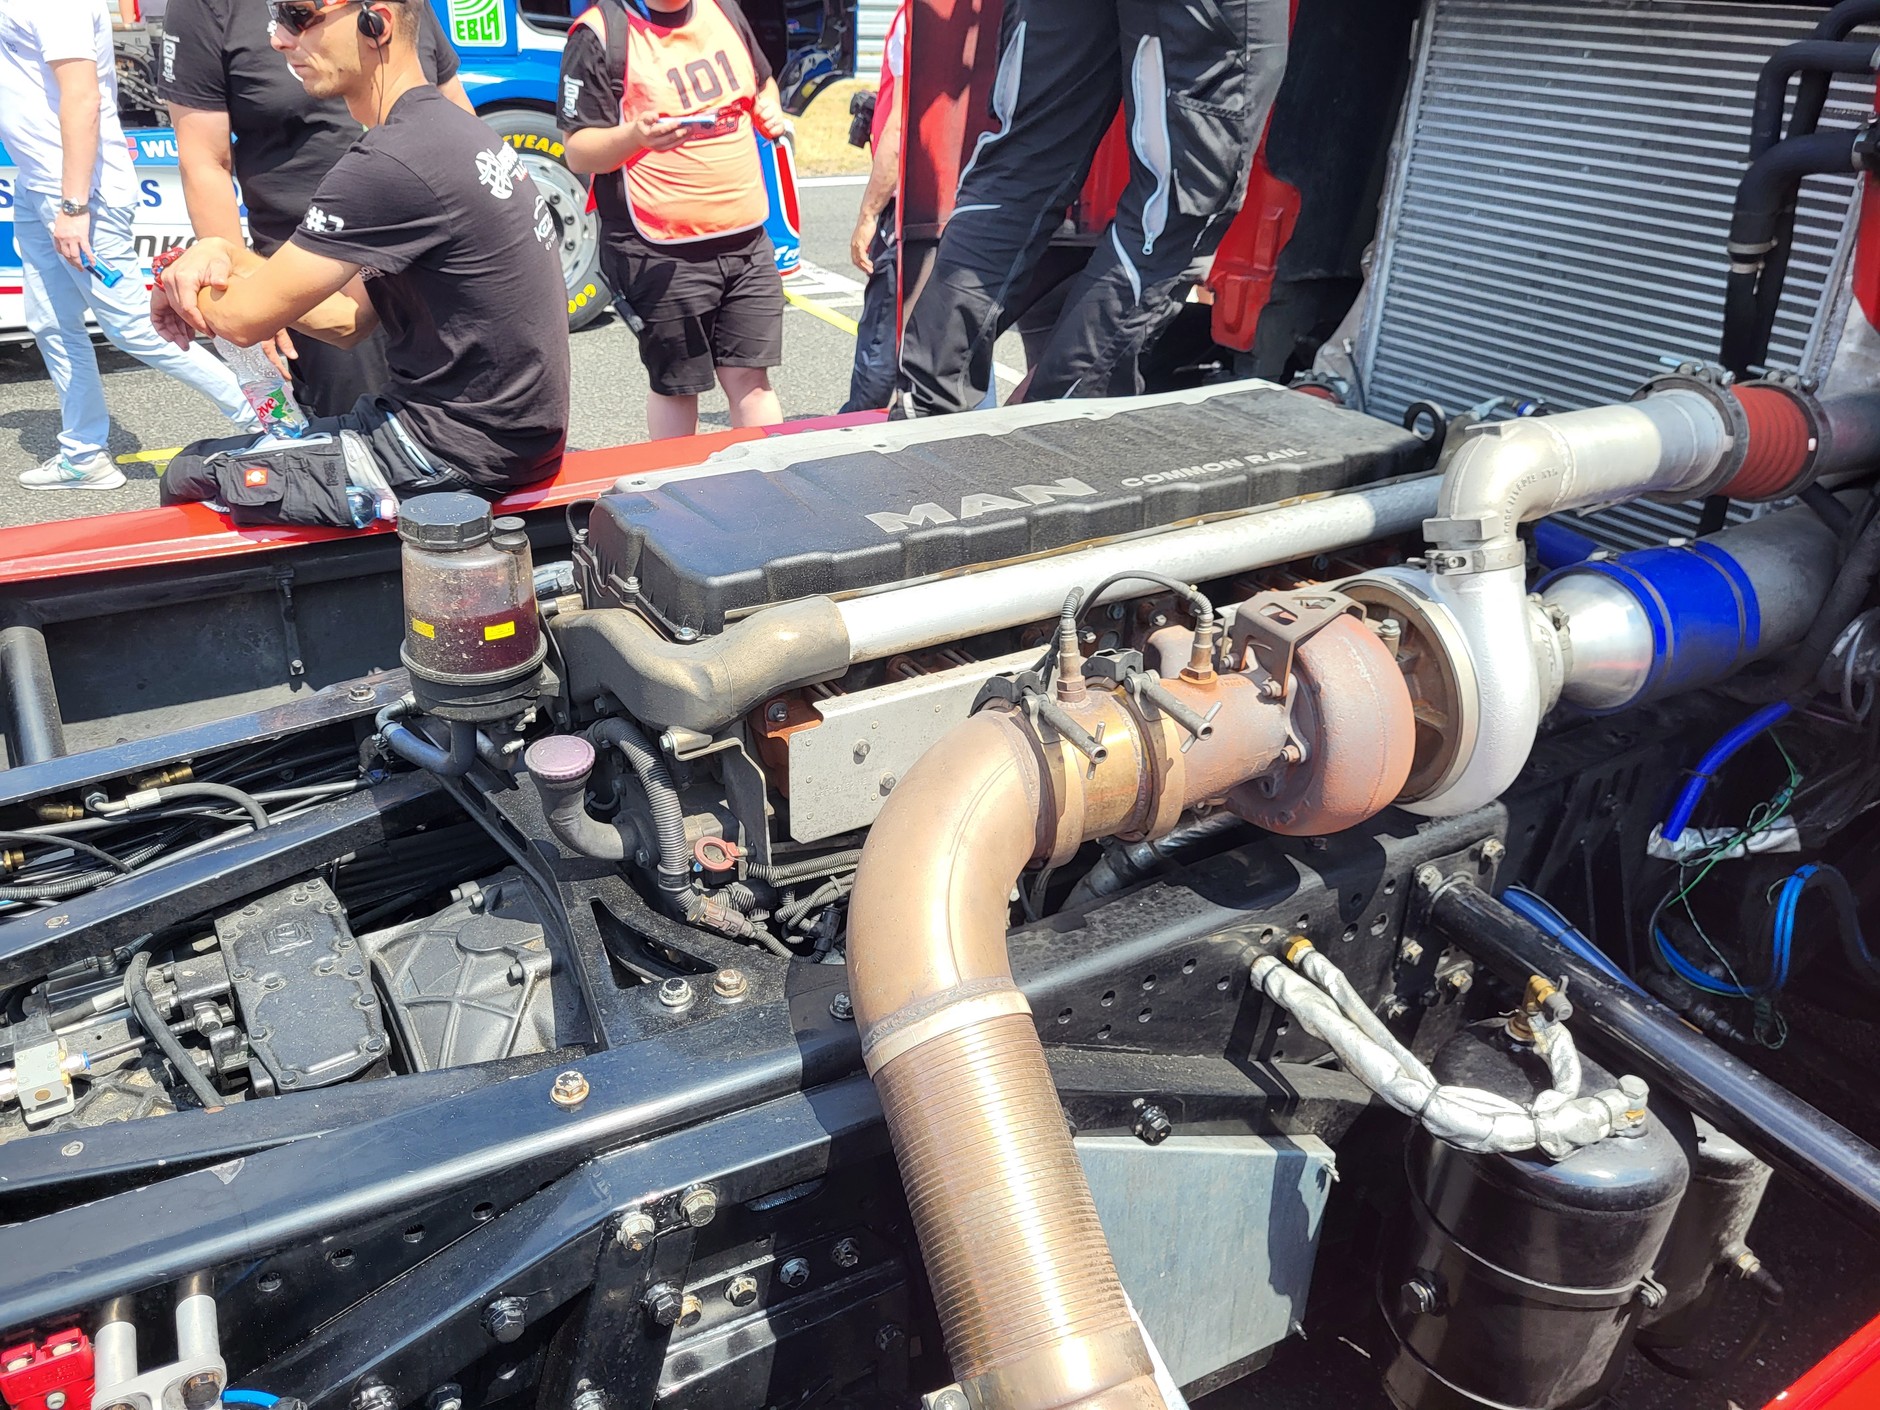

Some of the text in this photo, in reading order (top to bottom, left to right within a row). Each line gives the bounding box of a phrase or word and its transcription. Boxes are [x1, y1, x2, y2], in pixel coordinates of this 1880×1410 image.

[667, 50, 740, 109] 101
[864, 448, 1307, 533] MAN COMMON RAIL
